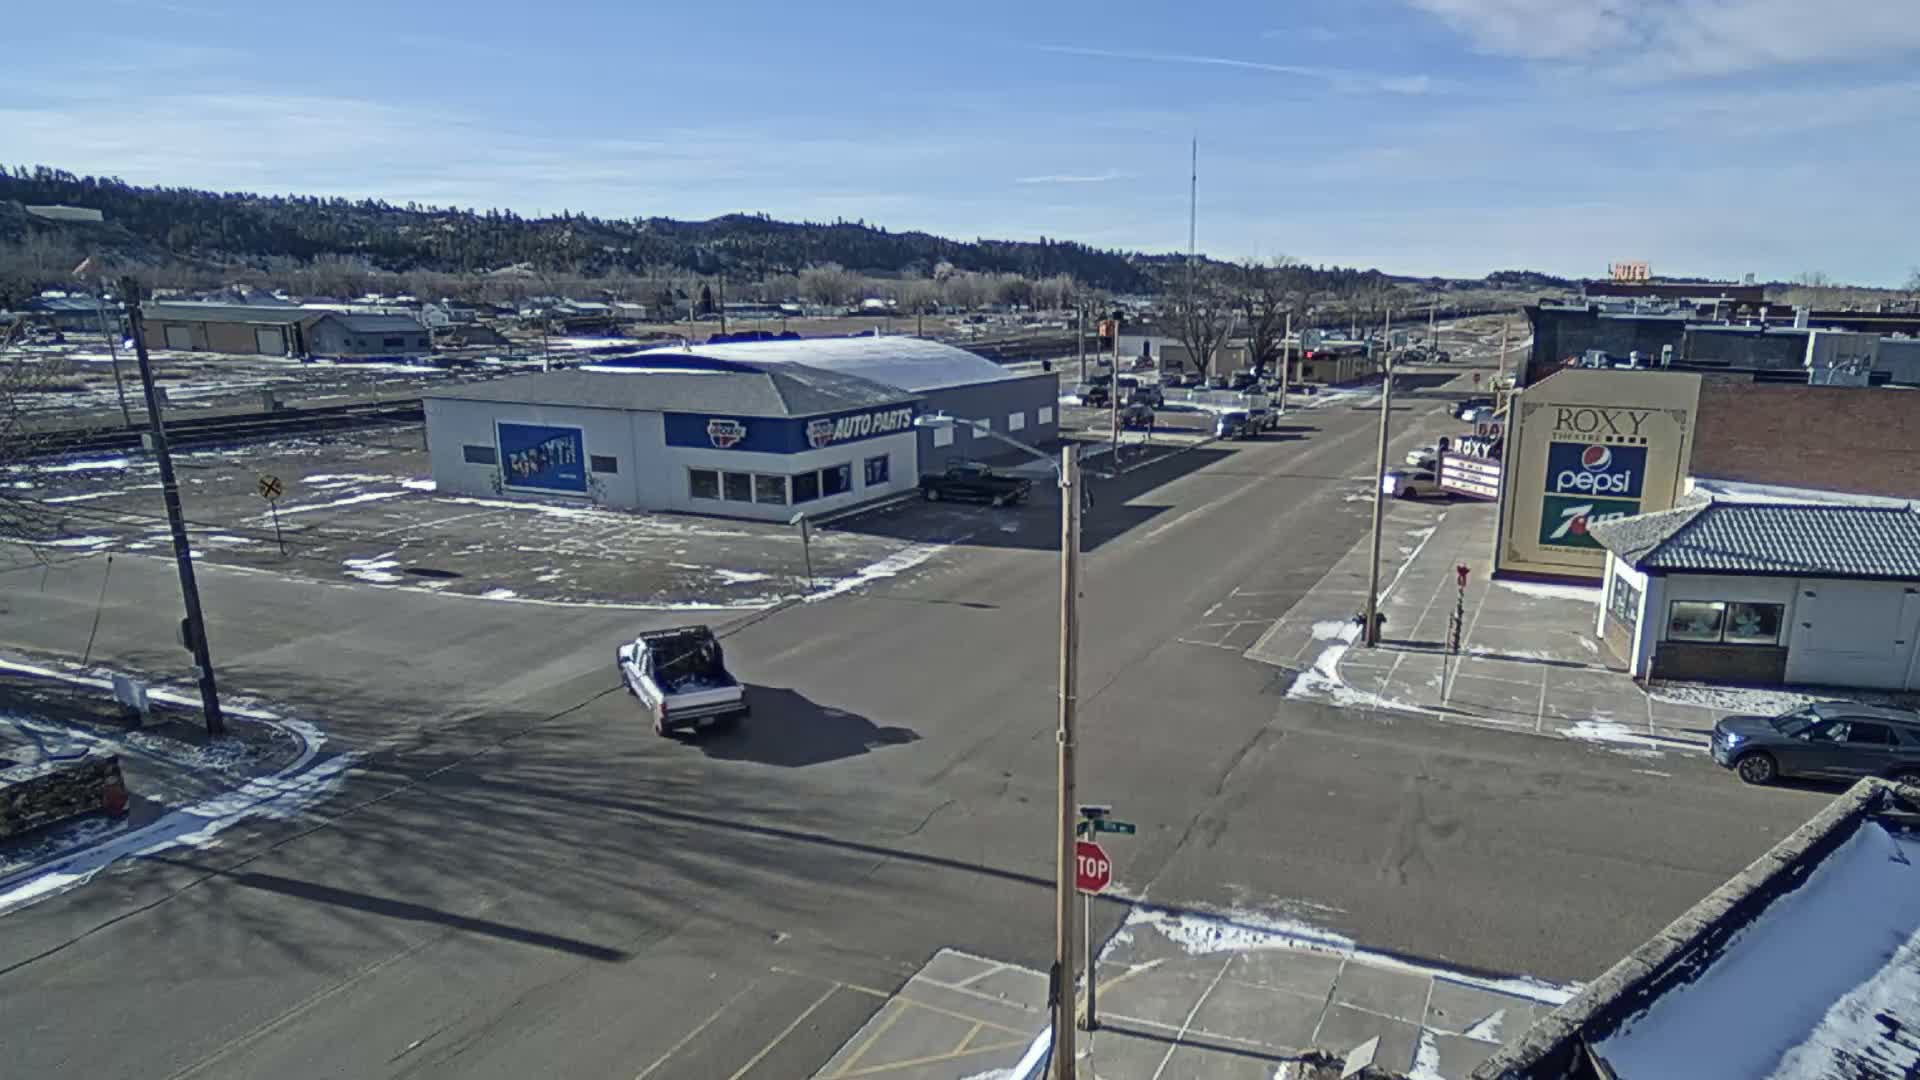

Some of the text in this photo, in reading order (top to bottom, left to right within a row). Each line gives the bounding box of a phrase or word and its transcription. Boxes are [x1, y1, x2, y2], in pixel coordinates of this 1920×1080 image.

[833, 414, 871, 440] AUTO
[872, 407, 912, 433] PARTS
[1552, 408, 1650, 435] ROXY
[1454, 438, 1491, 458] ROXY
[1557, 469, 1631, 495] pepsi
[1076, 856, 1108, 880] TOP
